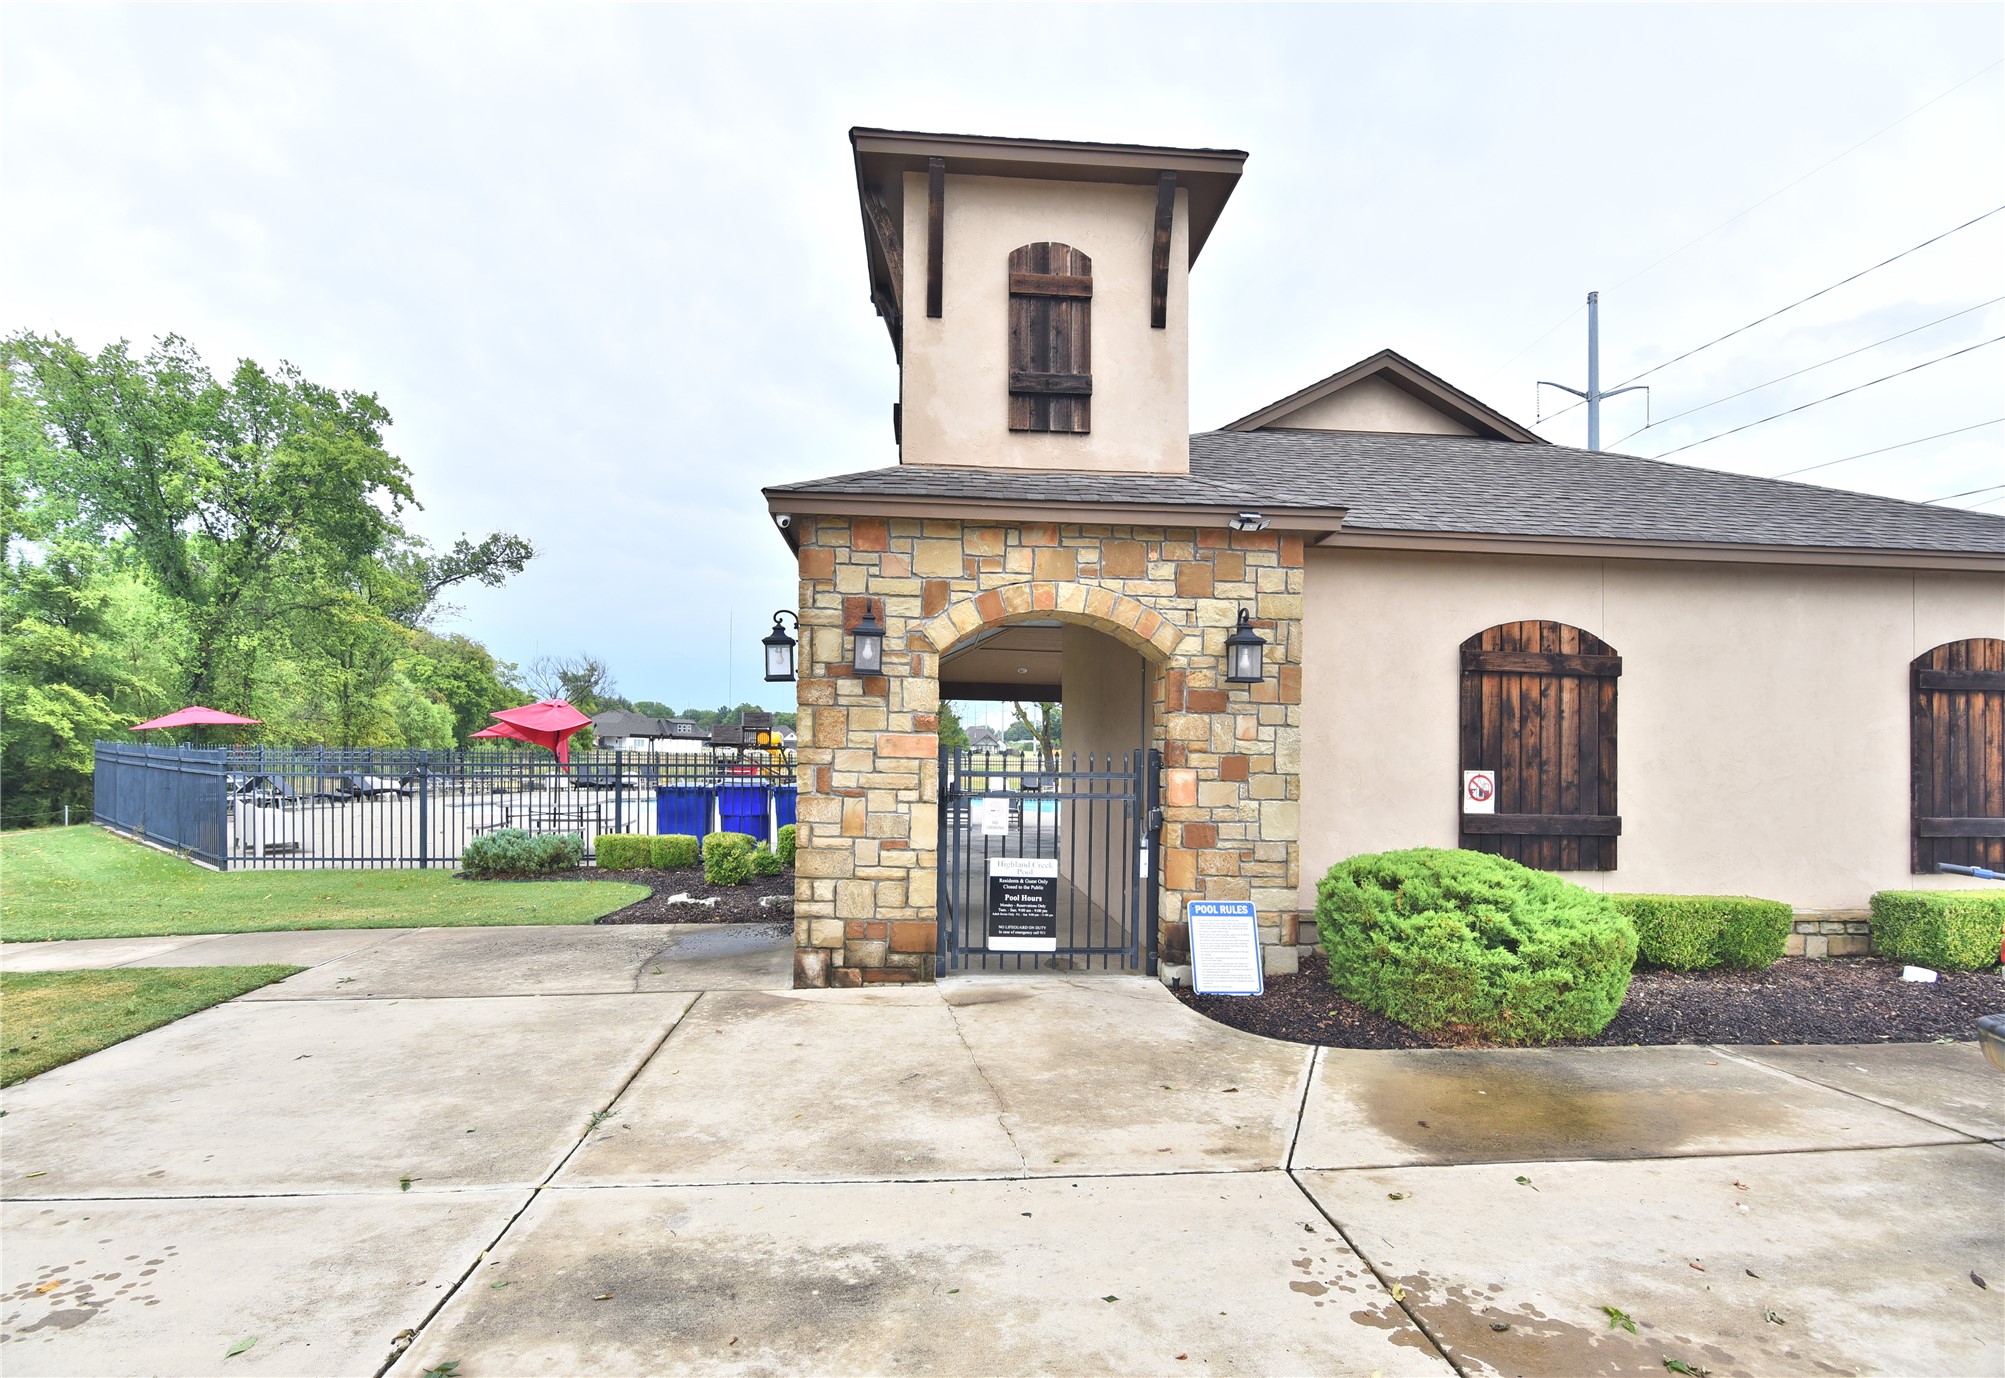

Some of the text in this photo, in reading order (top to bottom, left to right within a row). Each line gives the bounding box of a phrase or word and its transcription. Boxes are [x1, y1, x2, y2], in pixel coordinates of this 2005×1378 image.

[998, 860, 1030, 869] Highland
[1195, 905, 1248, 914] POOL RULES
